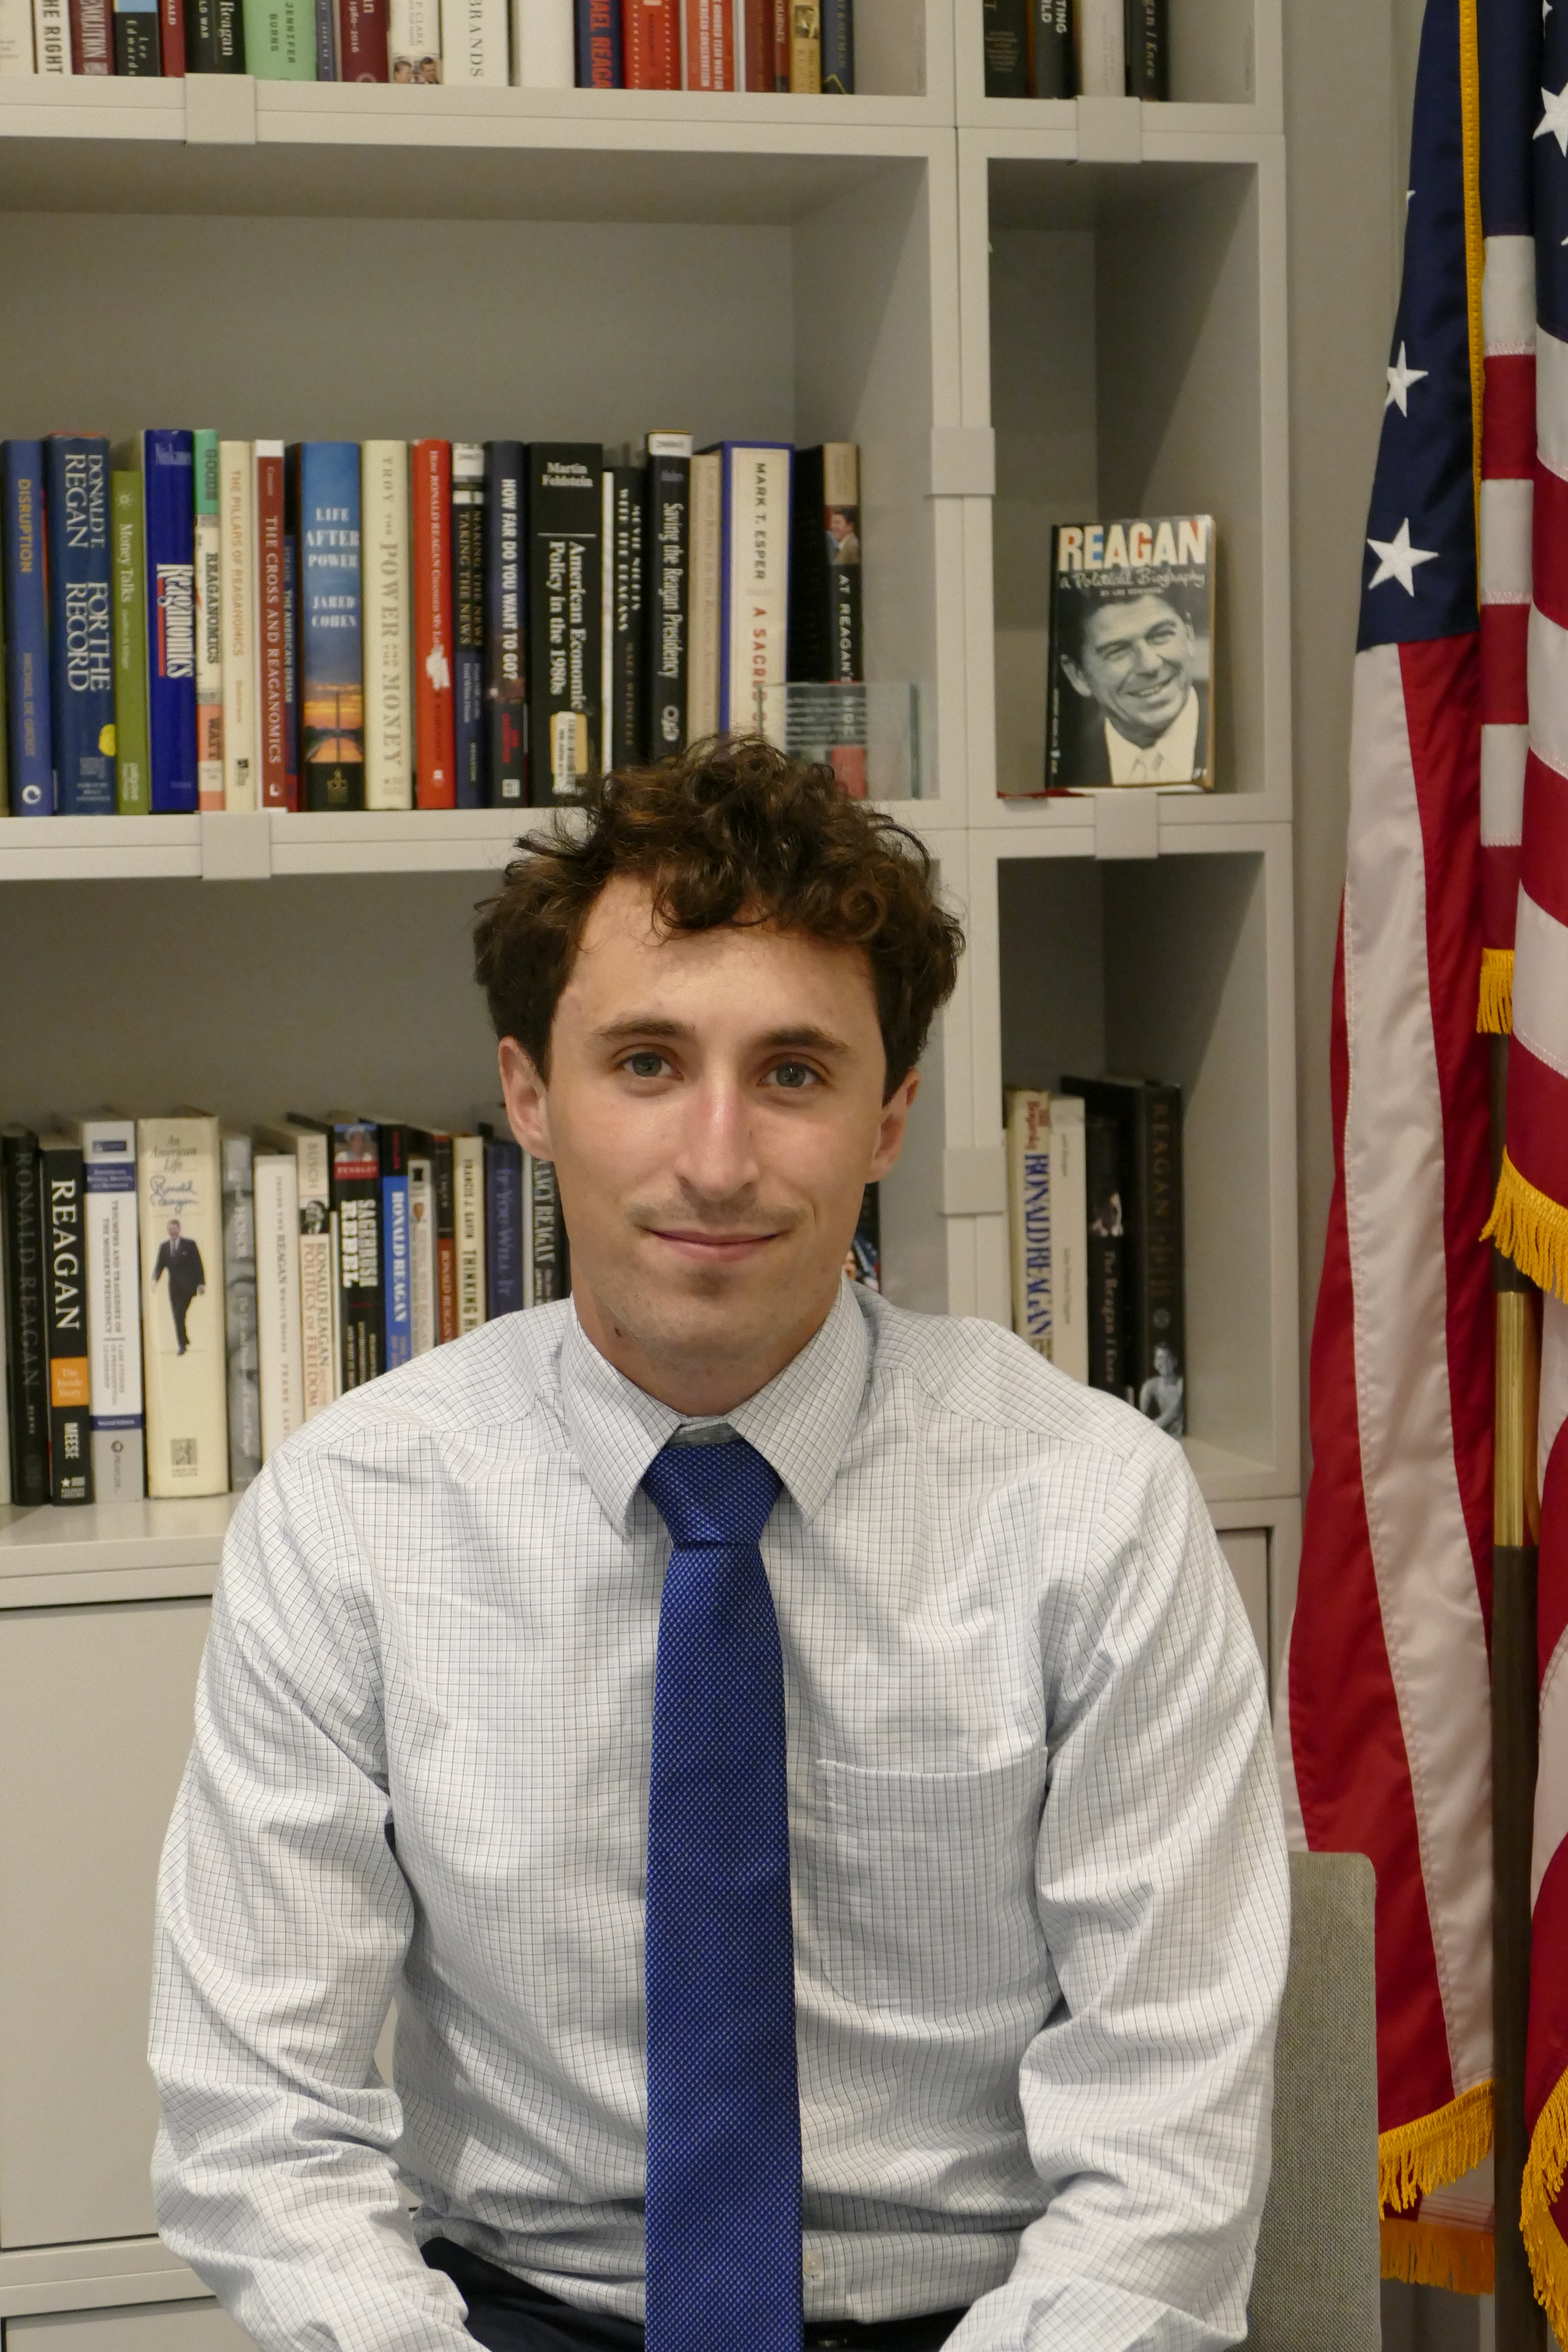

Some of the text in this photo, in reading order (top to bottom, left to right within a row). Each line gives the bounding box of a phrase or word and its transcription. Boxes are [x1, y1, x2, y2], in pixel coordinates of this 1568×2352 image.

[44, 25, 64, 74] RIGHT
[126, 19, 139, 76] Edwards
[138, 37, 150, 59] Lee
[199, 17, 210, 39] WAR
[218, 1, 235, 56] Reagan
[269, 13, 280, 52] BURNS
[285, 3, 296, 64] JENNIFER
[414, 12, 424, 46] CLARK
[469, 0, 484, 77] BRANDS
[589, 0, 612, 89] AEL REAGA
[65, 454, 89, 549] REGAN
[88, 454, 106, 549] DONALD T.
[381, 456, 395, 502] TROY
[18, 478, 32, 574] DISRUPTION
[306, 529, 359, 546] AFTER
[316, 507, 349, 521] LIFE
[429, 475, 441, 567] RONALD REAGAN
[658, 503, 684, 541] Saving
[755, 462, 768, 579] MARK T. ESPER
[116, 523, 133, 565] Money
[230, 469, 245, 656] THE PILLARS OF REAGANOMICS
[308, 554, 358, 568] POWER
[663, 545, 684, 564] the
[1058, 519, 1207, 573] REAGAN
[120, 569, 135, 603] Talks
[380, 543, 400, 637] POWER
[459, 511, 472, 646] TAKING THE NEWS
[501, 479, 519, 680] HOW FAR DO YOU WANT TO GO?
[657, 567, 684, 610] Reagan
[839, 574, 851, 594] AT
[1072, 571, 1132, 590] Political
[1135, 565, 1207, 589] Biography
[65, 582, 90, 692] RECORD
[87, 582, 111, 692] FOR THE
[156, 563, 195, 679] Reaganomics
[205, 552, 220, 664] REAGANOMICS
[311, 615, 357, 628] COHEN
[545, 541, 567, 696] Policy in the 1980s
[568, 540, 588, 713] American Economic
[752, 606, 768, 618] A
[265, 515, 283, 765] THE CROSS AND REAGANOMICS
[284, 611, 295, 665] AMERICAN
[656, 613, 684, 680] Presidency
[383, 674, 403, 766] MONEY
[150, 1145, 198, 1158] American
[164, 1157, 183, 1172] Life
[166, 1135, 181, 1146] An
[1152, 1104, 1171, 1216] REAGAN
[150, 1174, 198, 1196] Ronald
[111, 1200, 119, 1247] TRIUMPHS
[340, 1200, 358, 1289] REBEL
[357, 1198, 378, 1288] SAGEBRUSH
[392, 1191, 406, 1258] RONALD
[533, 1205, 555, 1264] REAGAN
[1024, 1153, 1052, 1337] RONALD REAGAN
[15, 1151, 40, 1387] RONALD REAGAN
[51, 1178, 81, 1329] REAGAN
[103, 1237, 111, 1274] MODERN
[276, 1234, 288, 1284] REAGAN
[304, 1242, 317, 1311] POLITICS
[315, 1242, 329, 1303] RONALD
[462, 1249, 479, 1314] THINKING
[104, 1277, 112, 1333] PRESIDENCY
[113, 1271, 122, 1319] TRAGEDIES
[393, 1259, 408, 1323] REAGAN
[1101, 1277, 1118, 1334] Reagan
[317, 1306, 330, 1368] REAGAN
[280, 1362, 290, 1403] FRANK
[306, 1334, 318, 1407] FREEDOM
[64, 1422, 80, 1460] MEESE
